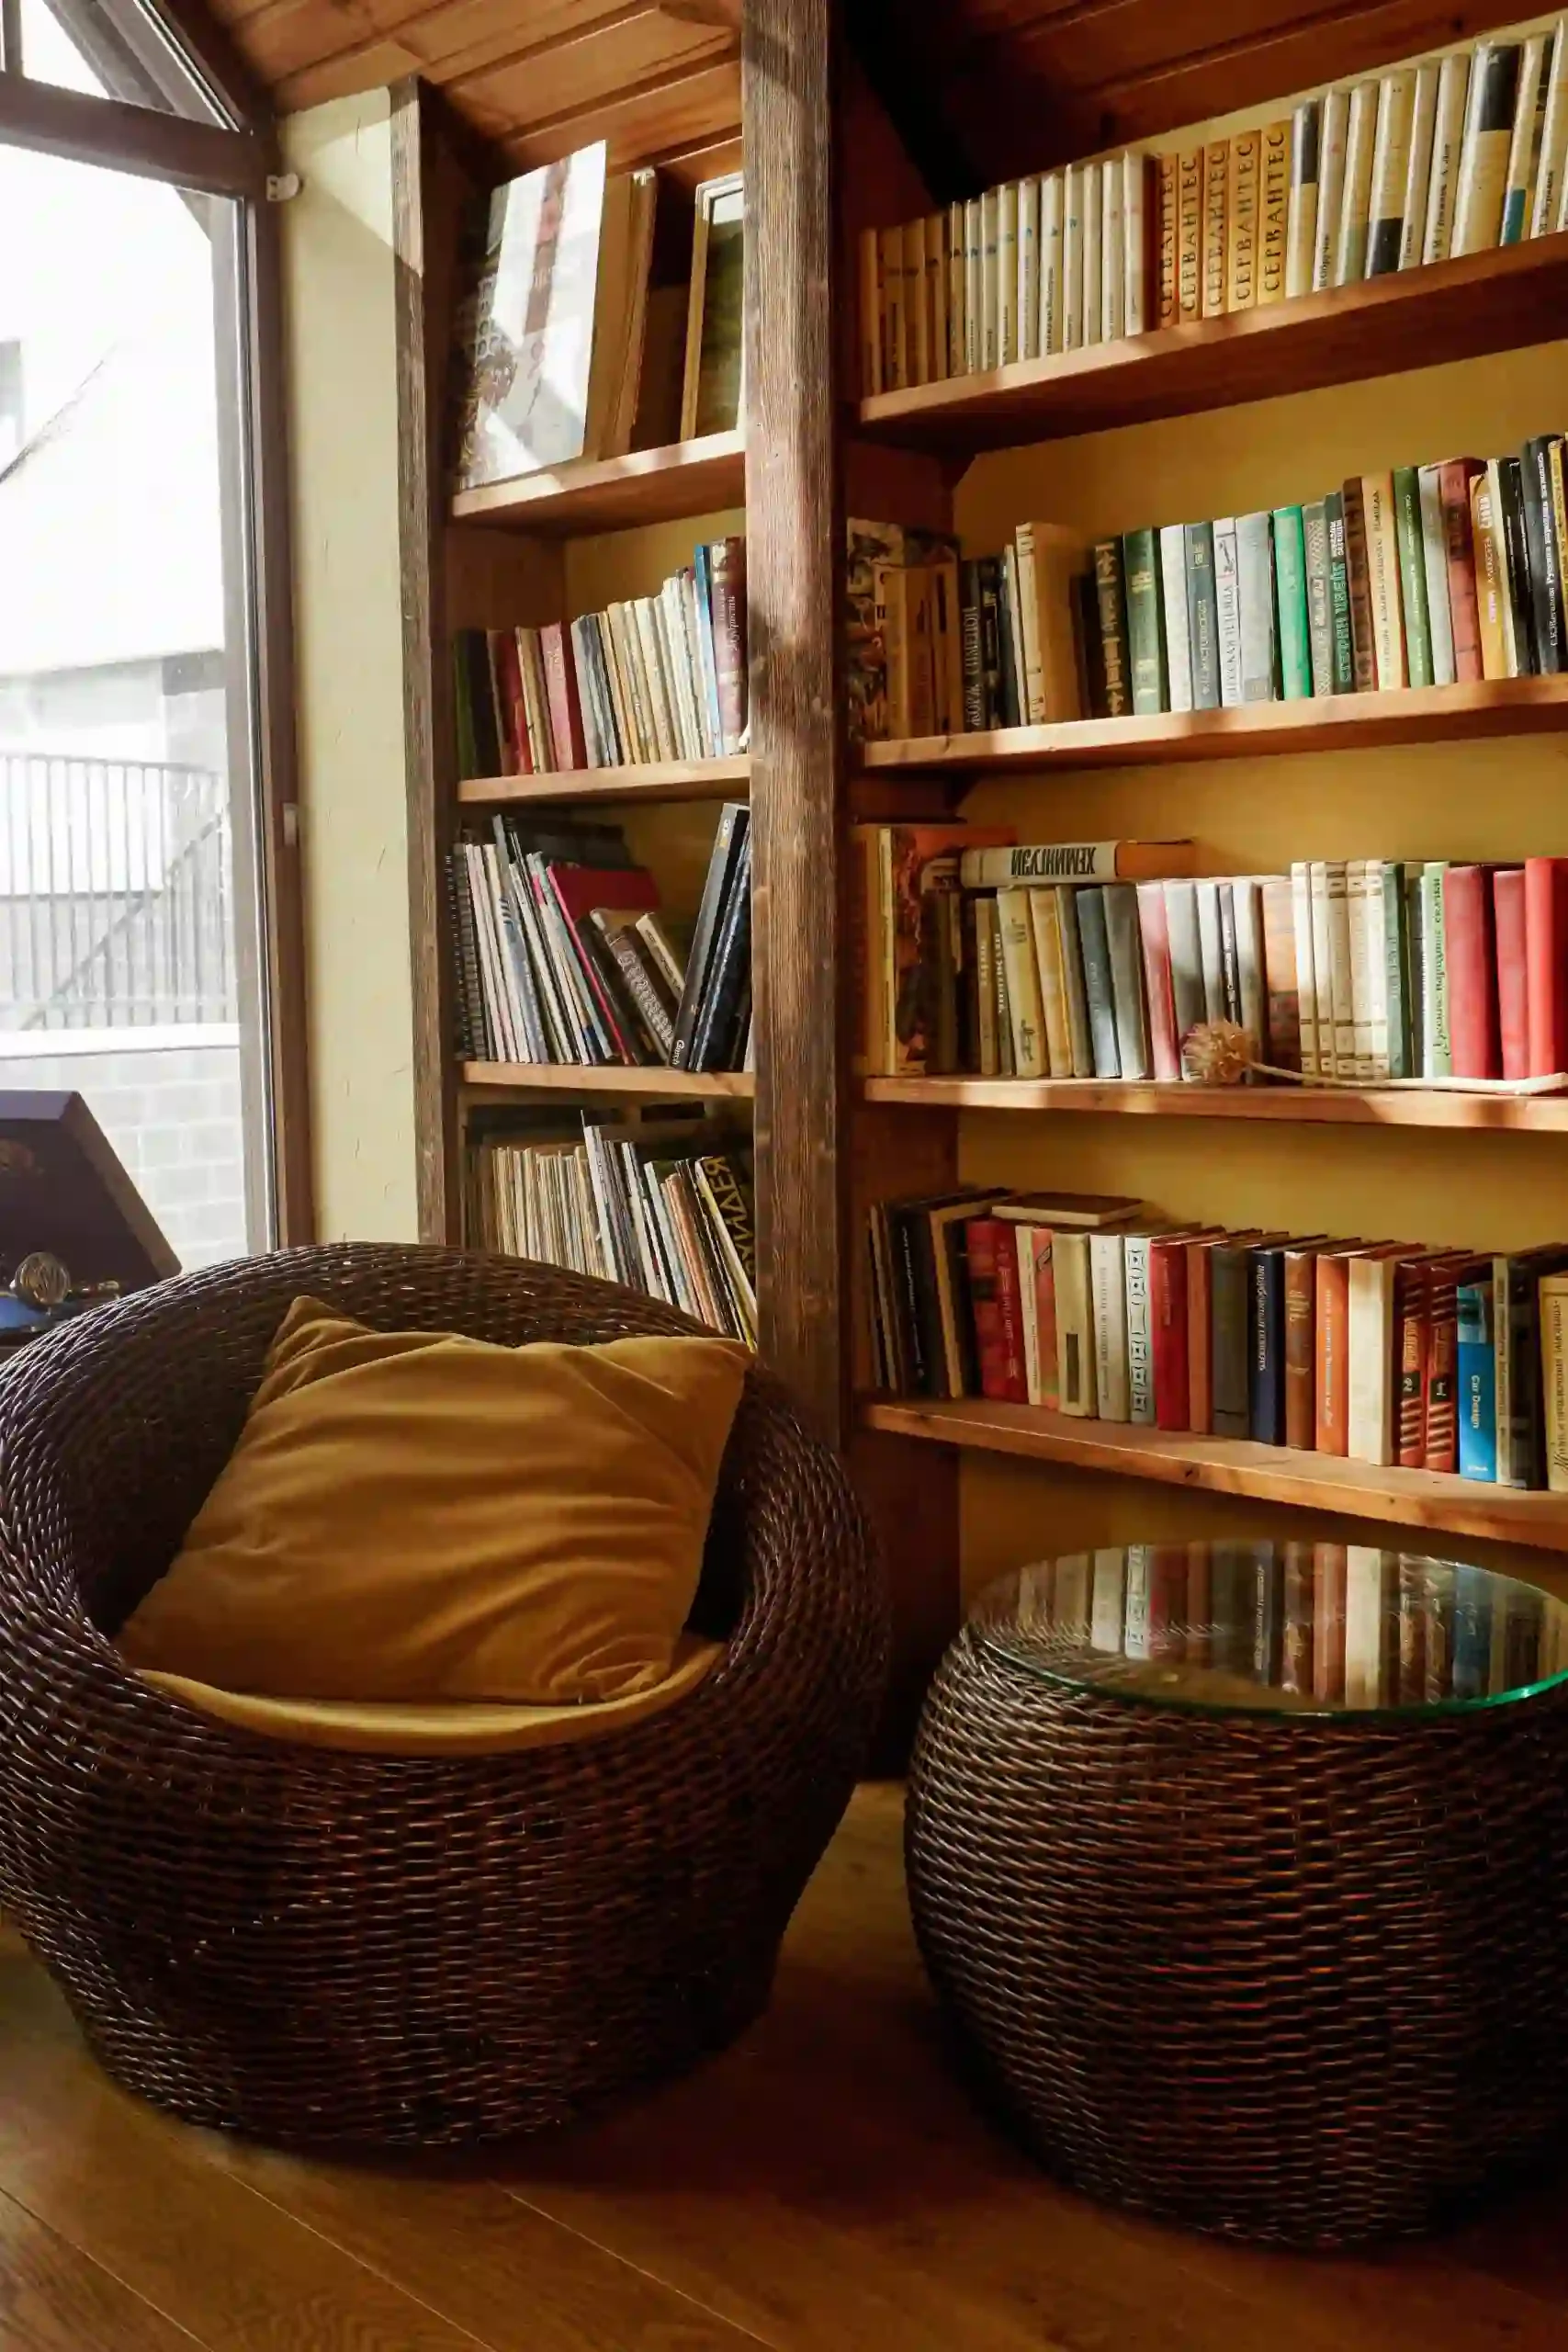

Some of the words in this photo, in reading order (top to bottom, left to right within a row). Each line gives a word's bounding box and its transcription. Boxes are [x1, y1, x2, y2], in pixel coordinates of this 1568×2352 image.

[1236, 141, 1254, 301] СЕРВАНТЕС
[1265, 130, 1285, 291] СЕРВАНТЕС
[1181, 157, 1198, 311] СЕРВАНТЕС
[1208, 150, 1226, 307] СЕРВАНТЕС
[1010, 846, 1097, 879] ХЕМИНГУЭЙ
[1403, 1377, 1414, 1393] 2
[1436, 1381, 1447, 1396] 1
[1471, 1374, 1481, 1393] Car
[1471, 1395, 1481, 1429] Design
